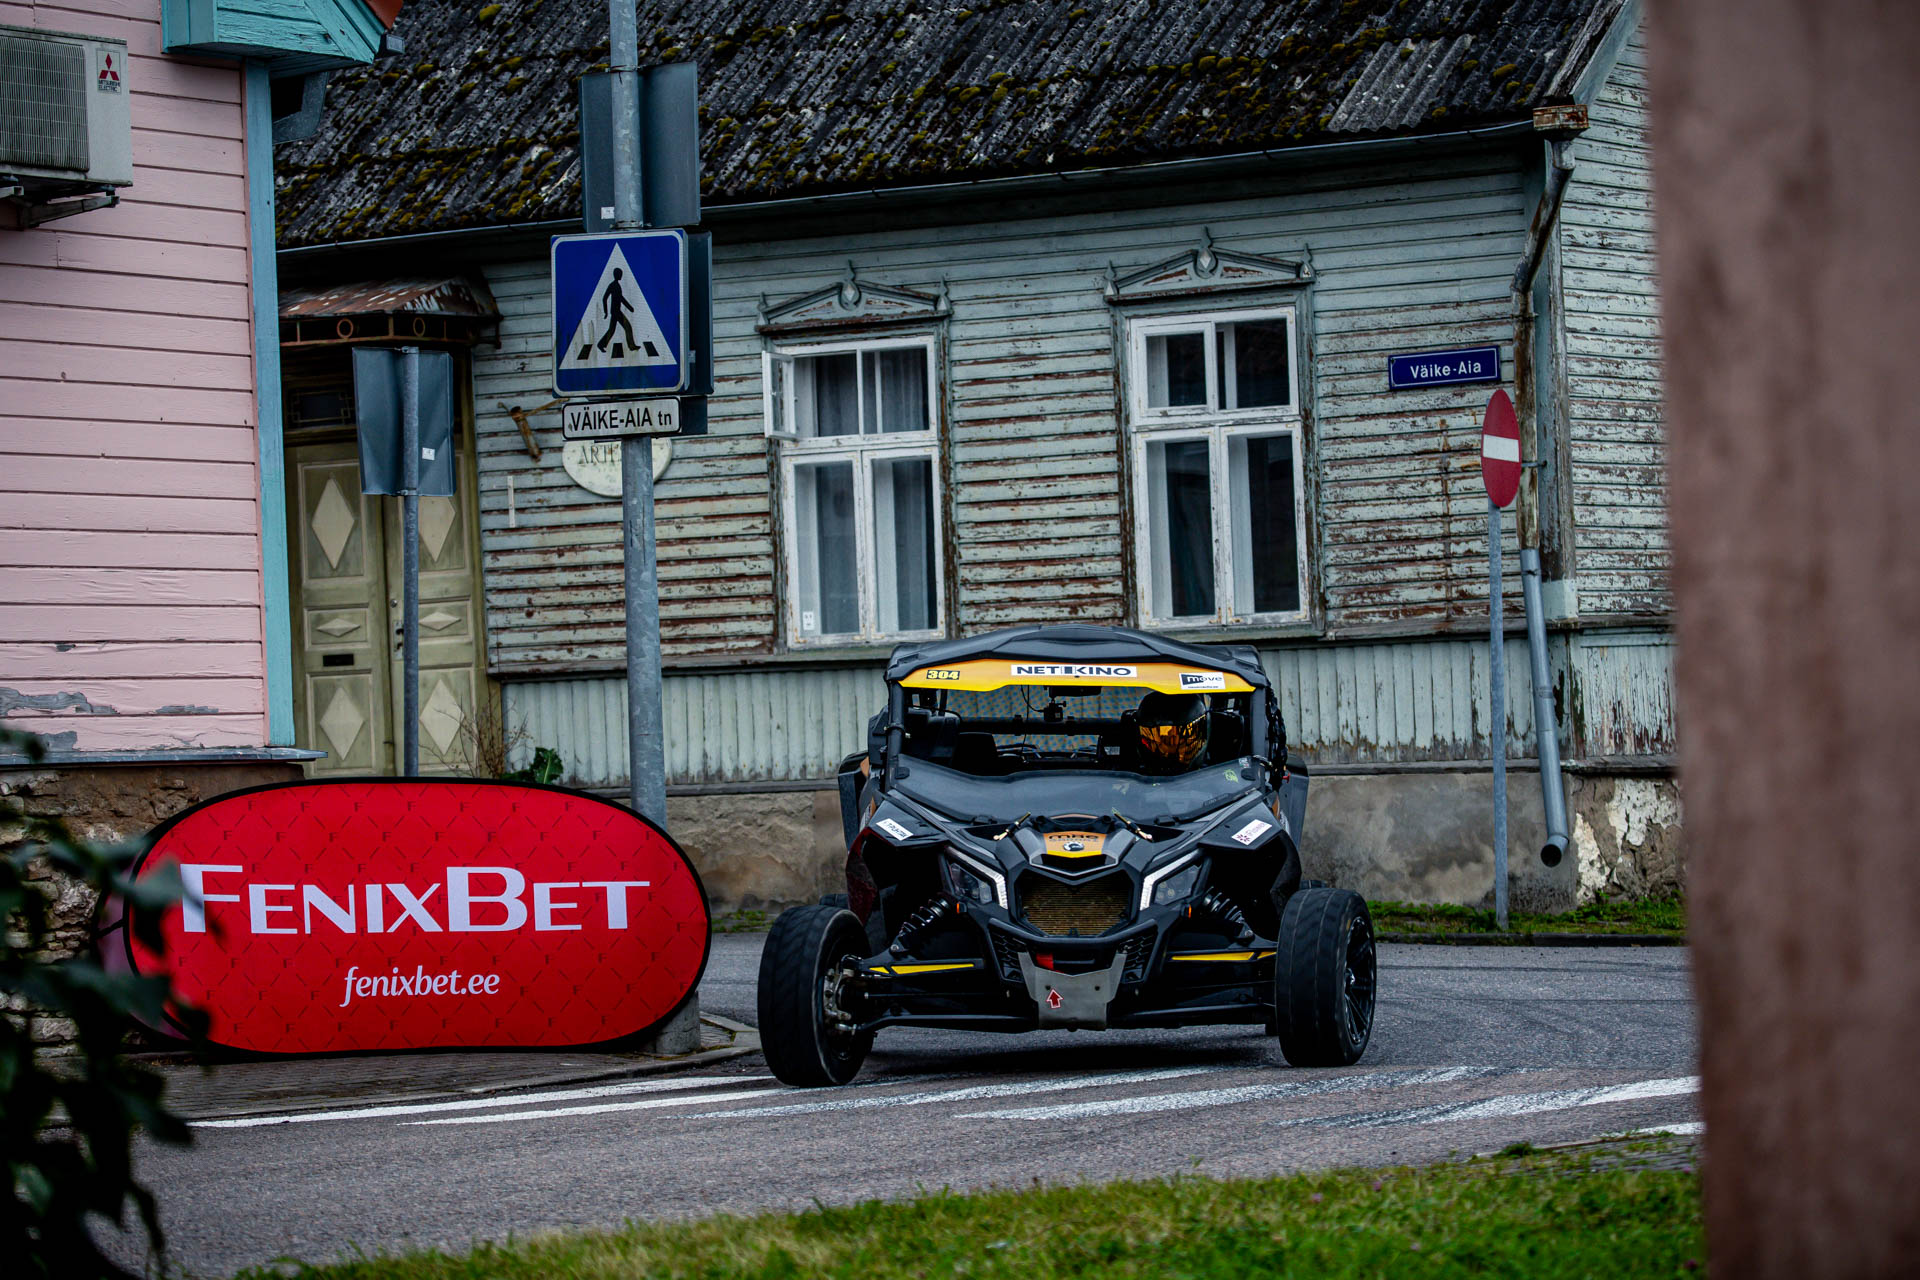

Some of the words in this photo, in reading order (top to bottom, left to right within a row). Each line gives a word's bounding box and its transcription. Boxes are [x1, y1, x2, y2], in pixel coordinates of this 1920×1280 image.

[1410, 360, 1482, 379] Väike-Aia
[570, 406, 653, 432] VÄIKE-AIA
[657, 411, 672, 426] tn
[927, 670, 959, 680] 304
[1186, 675, 1223, 683] move
[339, 965, 501, 1008] fenixbet.ee
